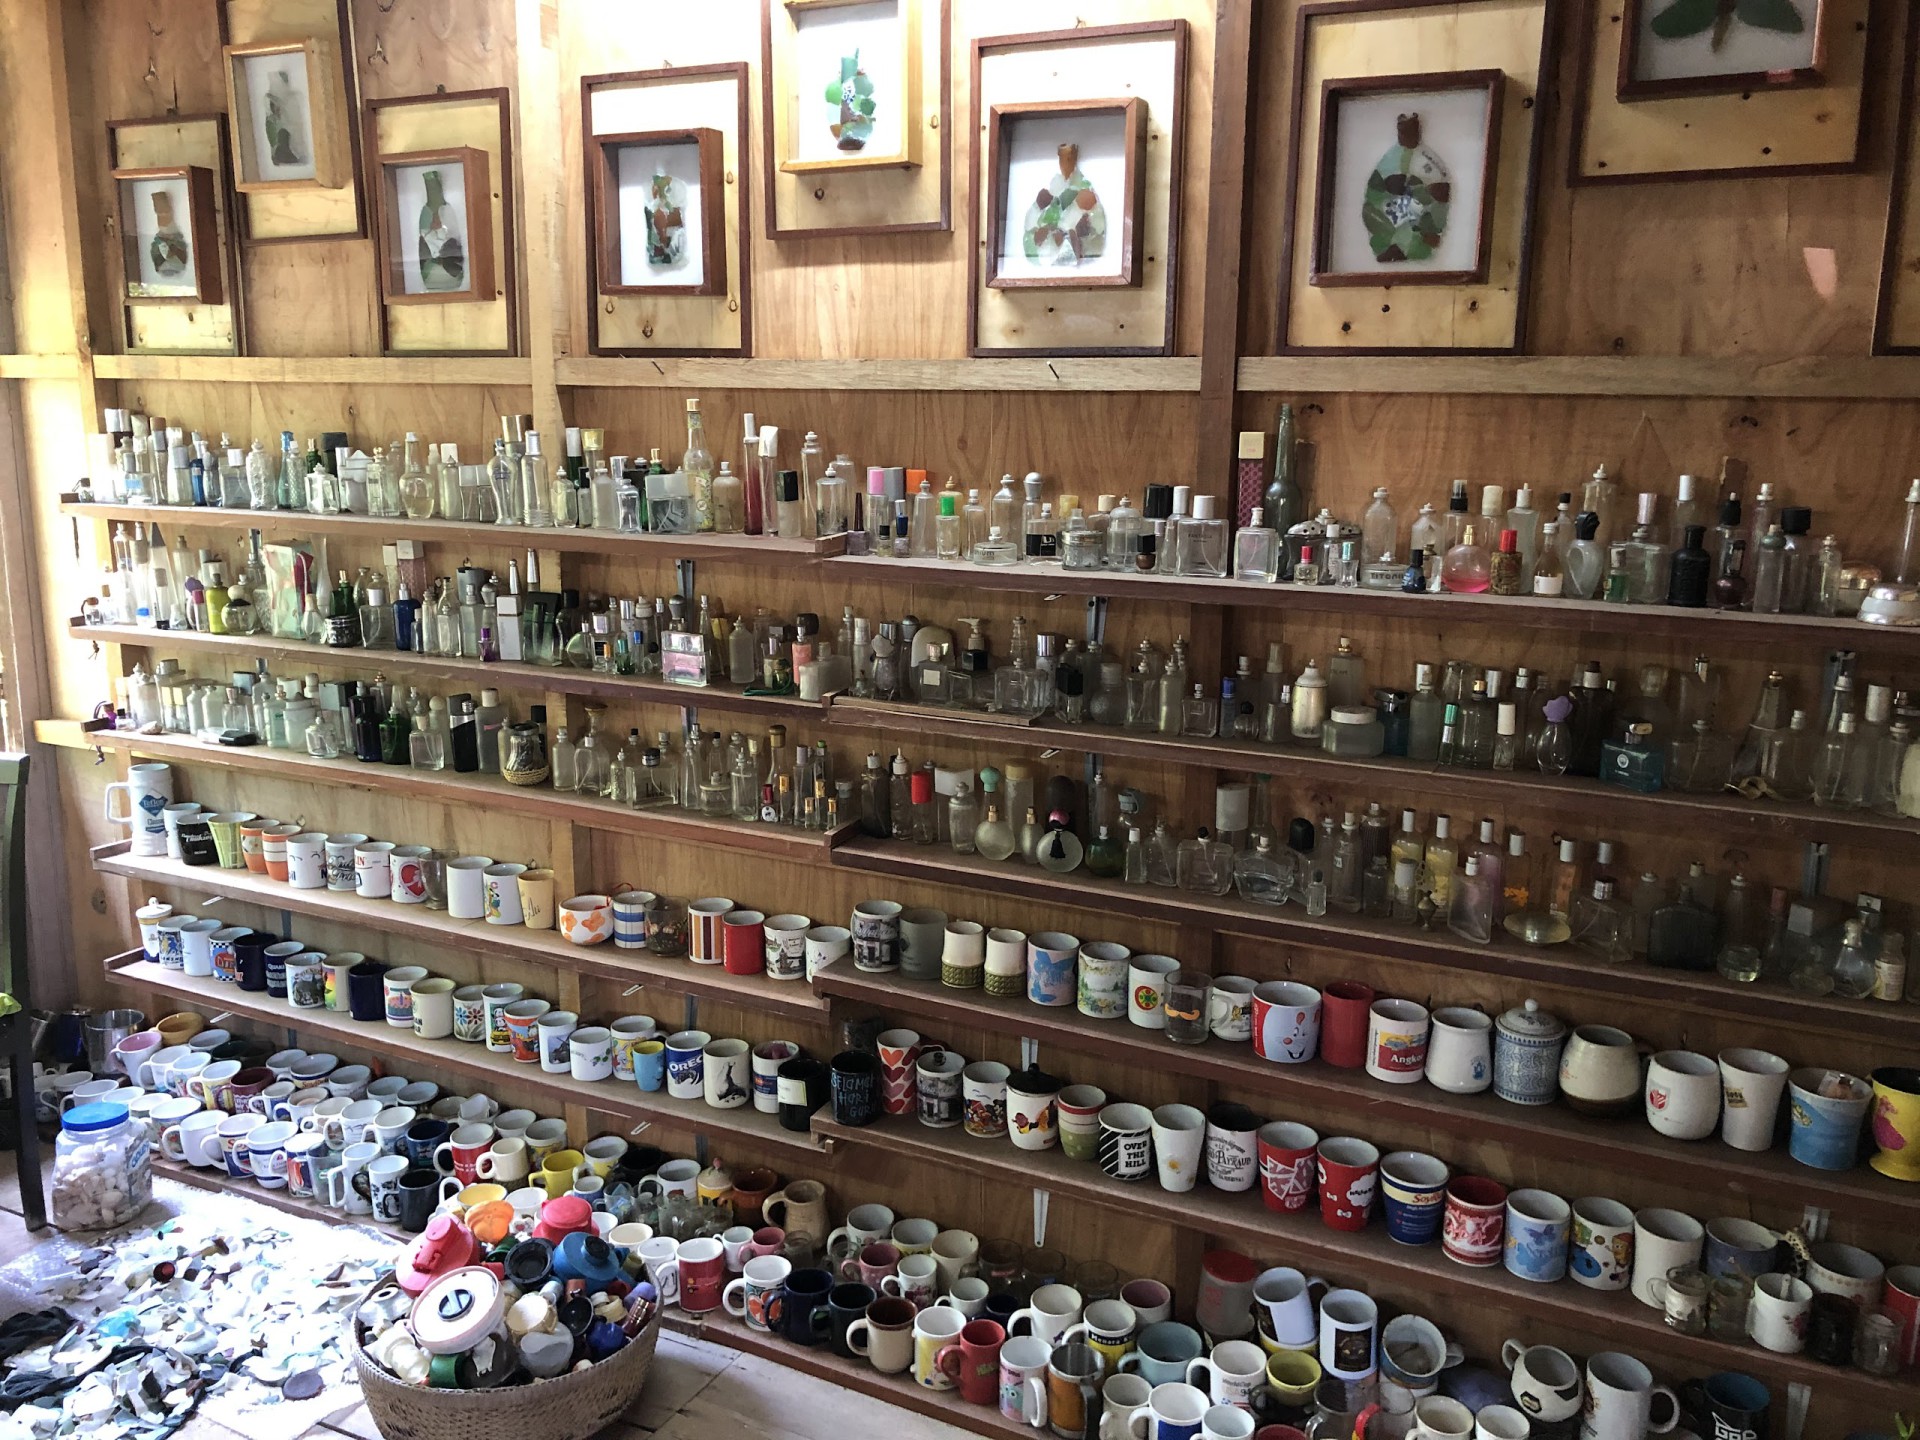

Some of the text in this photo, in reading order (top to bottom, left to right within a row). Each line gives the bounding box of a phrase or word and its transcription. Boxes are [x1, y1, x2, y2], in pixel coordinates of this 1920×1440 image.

[1123, 1140, 1148, 1151] OVER
[1126, 1151, 1146, 1160] THE
[1124, 1160, 1147, 1169] HILL
